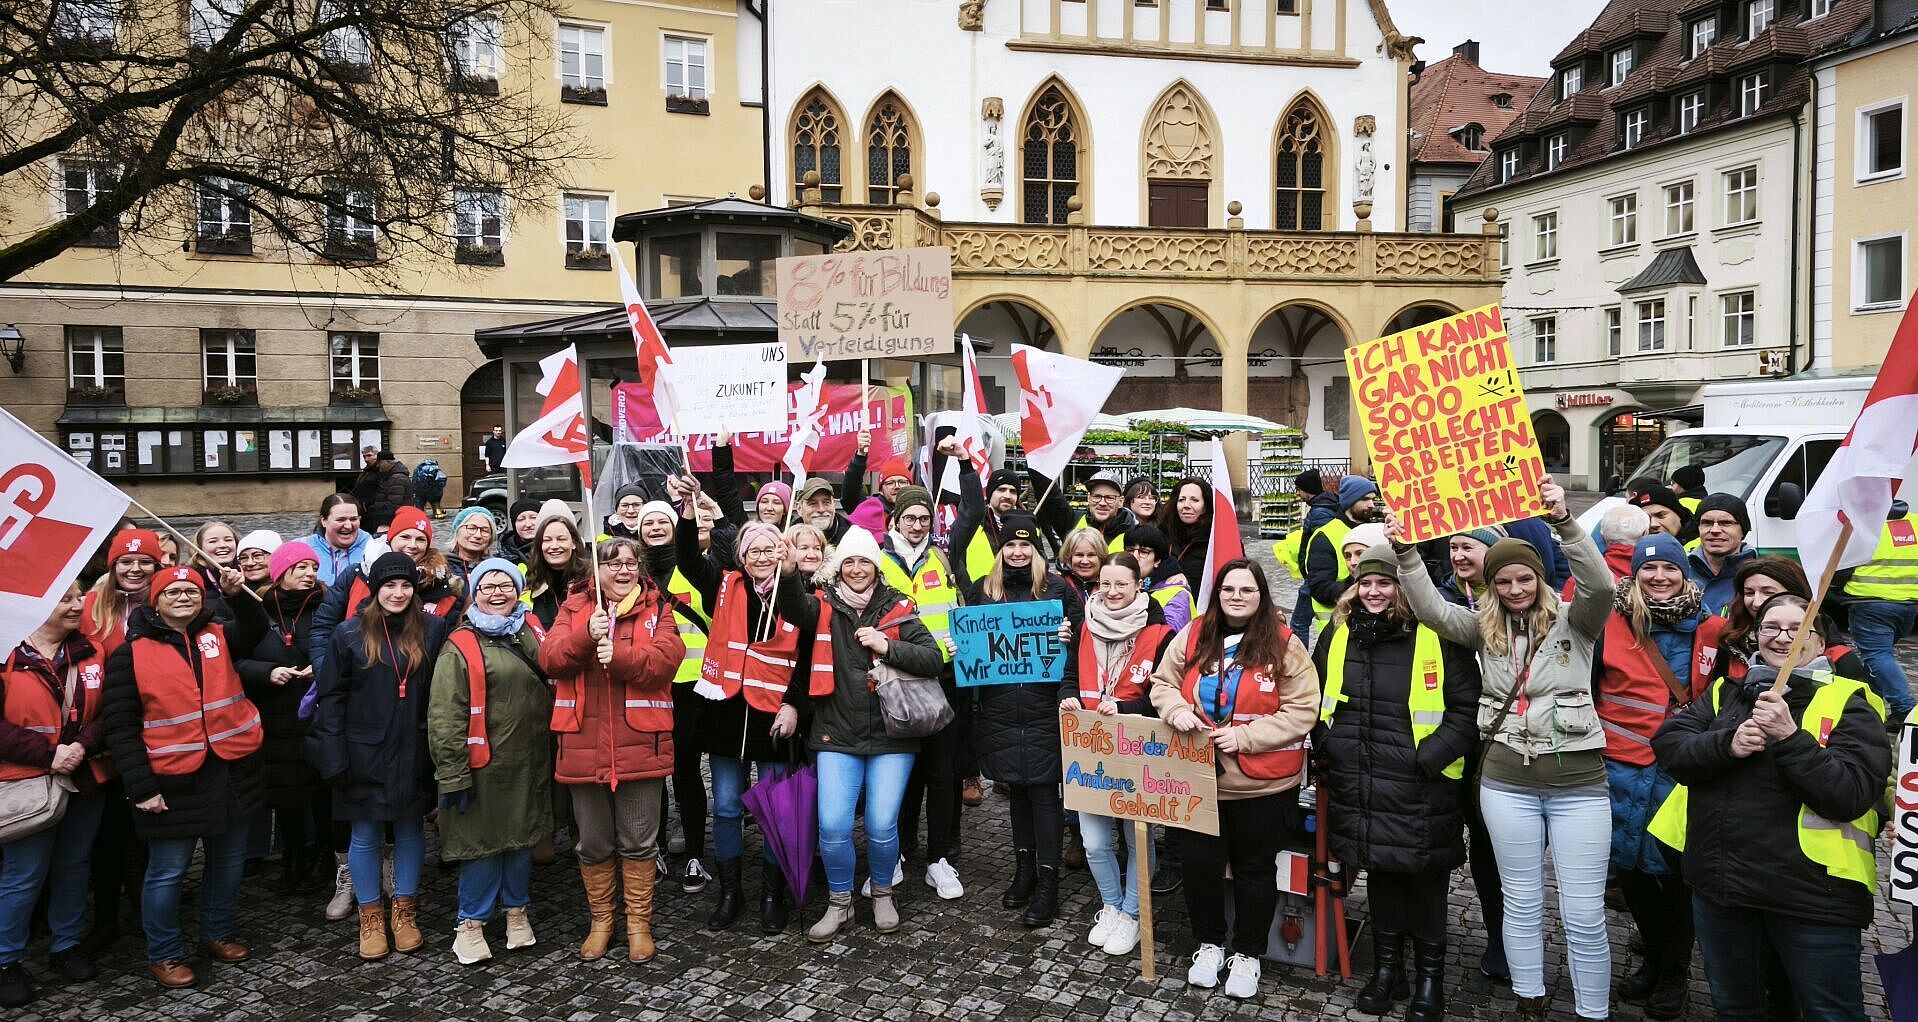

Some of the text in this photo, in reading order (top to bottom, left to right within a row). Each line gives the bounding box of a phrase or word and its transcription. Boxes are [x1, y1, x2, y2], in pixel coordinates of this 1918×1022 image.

[785, 254, 950, 309] 8% für Bildung
[829, 302, 877, 333] 5%
[880, 301, 911, 332] für
[1416, 305, 1504, 357] KANN
[761, 346, 785, 362] UNS
[799, 333, 935, 356] Verteidigung
[1358, 363, 1429, 408] GAR
[828, 406, 882, 436] WAHL!
[1368, 385, 1463, 437] SOOO
[1373, 396, 1522, 463] SCHLECHT
[952, 611, 1064, 635] Kinder brauchen
[987, 630, 1061, 662] KNETE
[957, 658, 992, 682] Wir
[1061, 712, 1115, 755] Profis
[1167, 731, 1215, 768] Arbeit
[1065, 760, 1191, 796] Amateure beim
